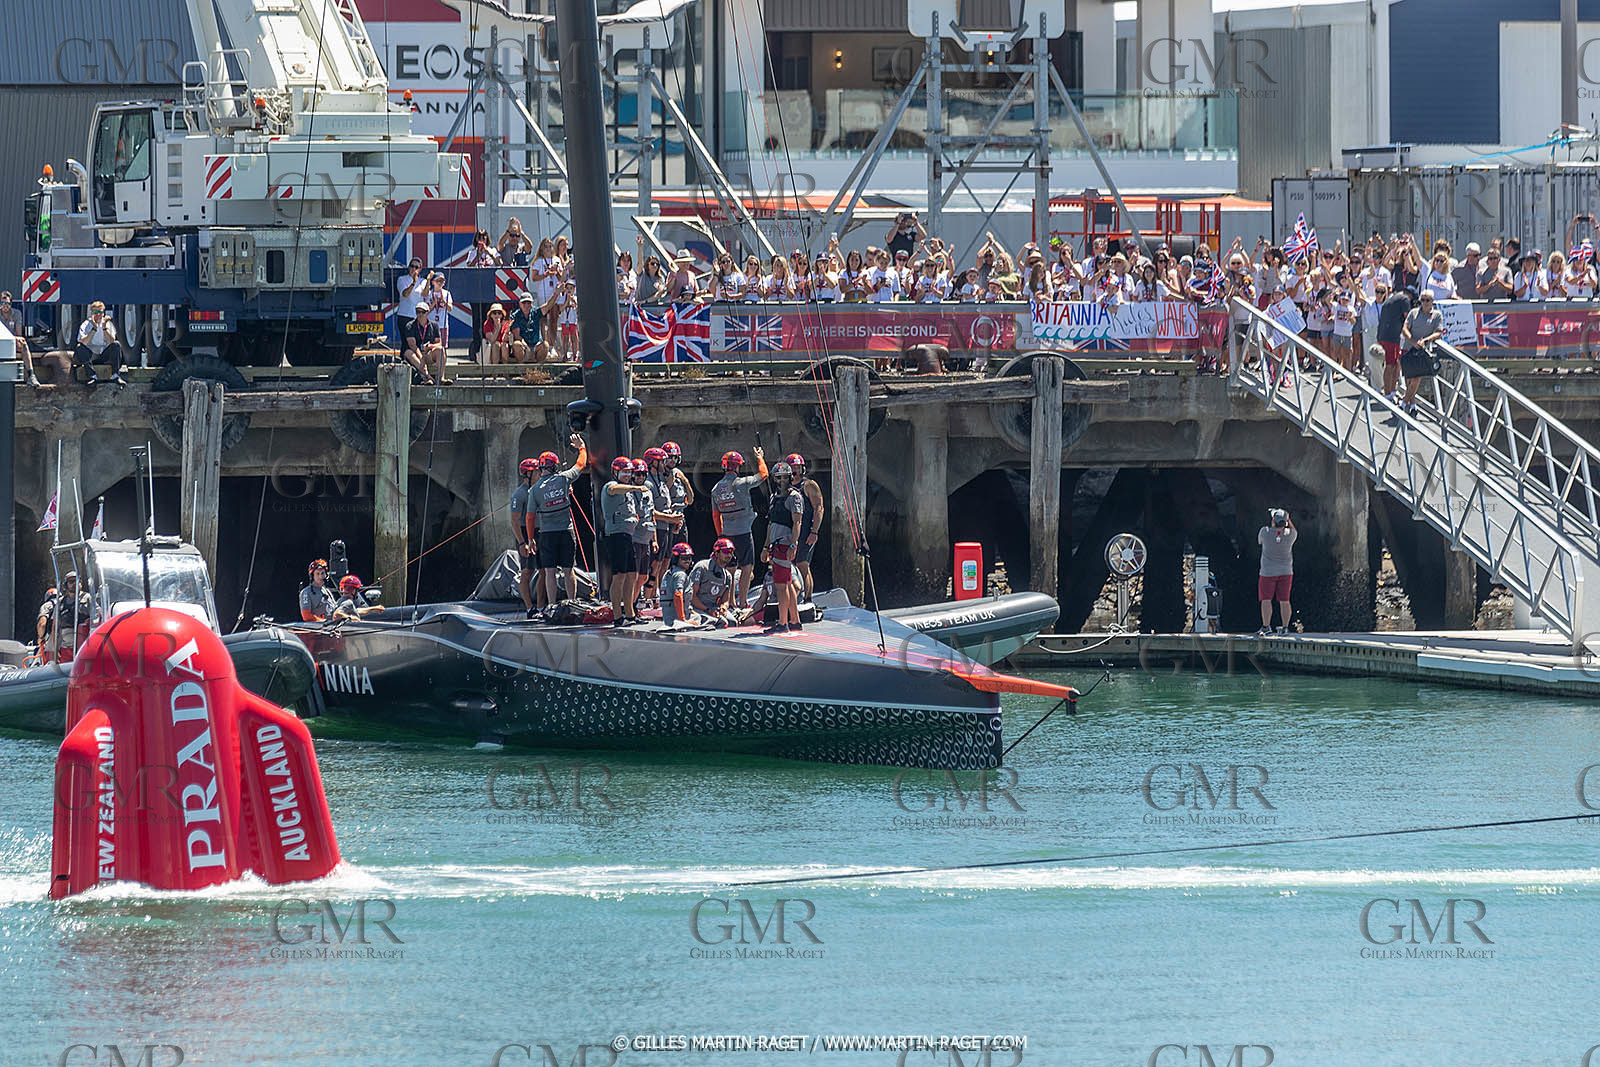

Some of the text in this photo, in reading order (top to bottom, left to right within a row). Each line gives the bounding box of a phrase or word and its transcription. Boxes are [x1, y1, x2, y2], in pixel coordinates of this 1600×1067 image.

[803, 325, 937, 338] #THEREISNOSECOND
[1031, 302, 1111, 326] BRITANNIA
[1154, 303, 1199, 338] WAVES
[913, 610, 996, 631] INEOS TEAM UK
[94, 726, 116, 835] ZEALAND
[165, 637, 227, 873] PRADA
[256, 723, 312, 862] AUCKLAND
